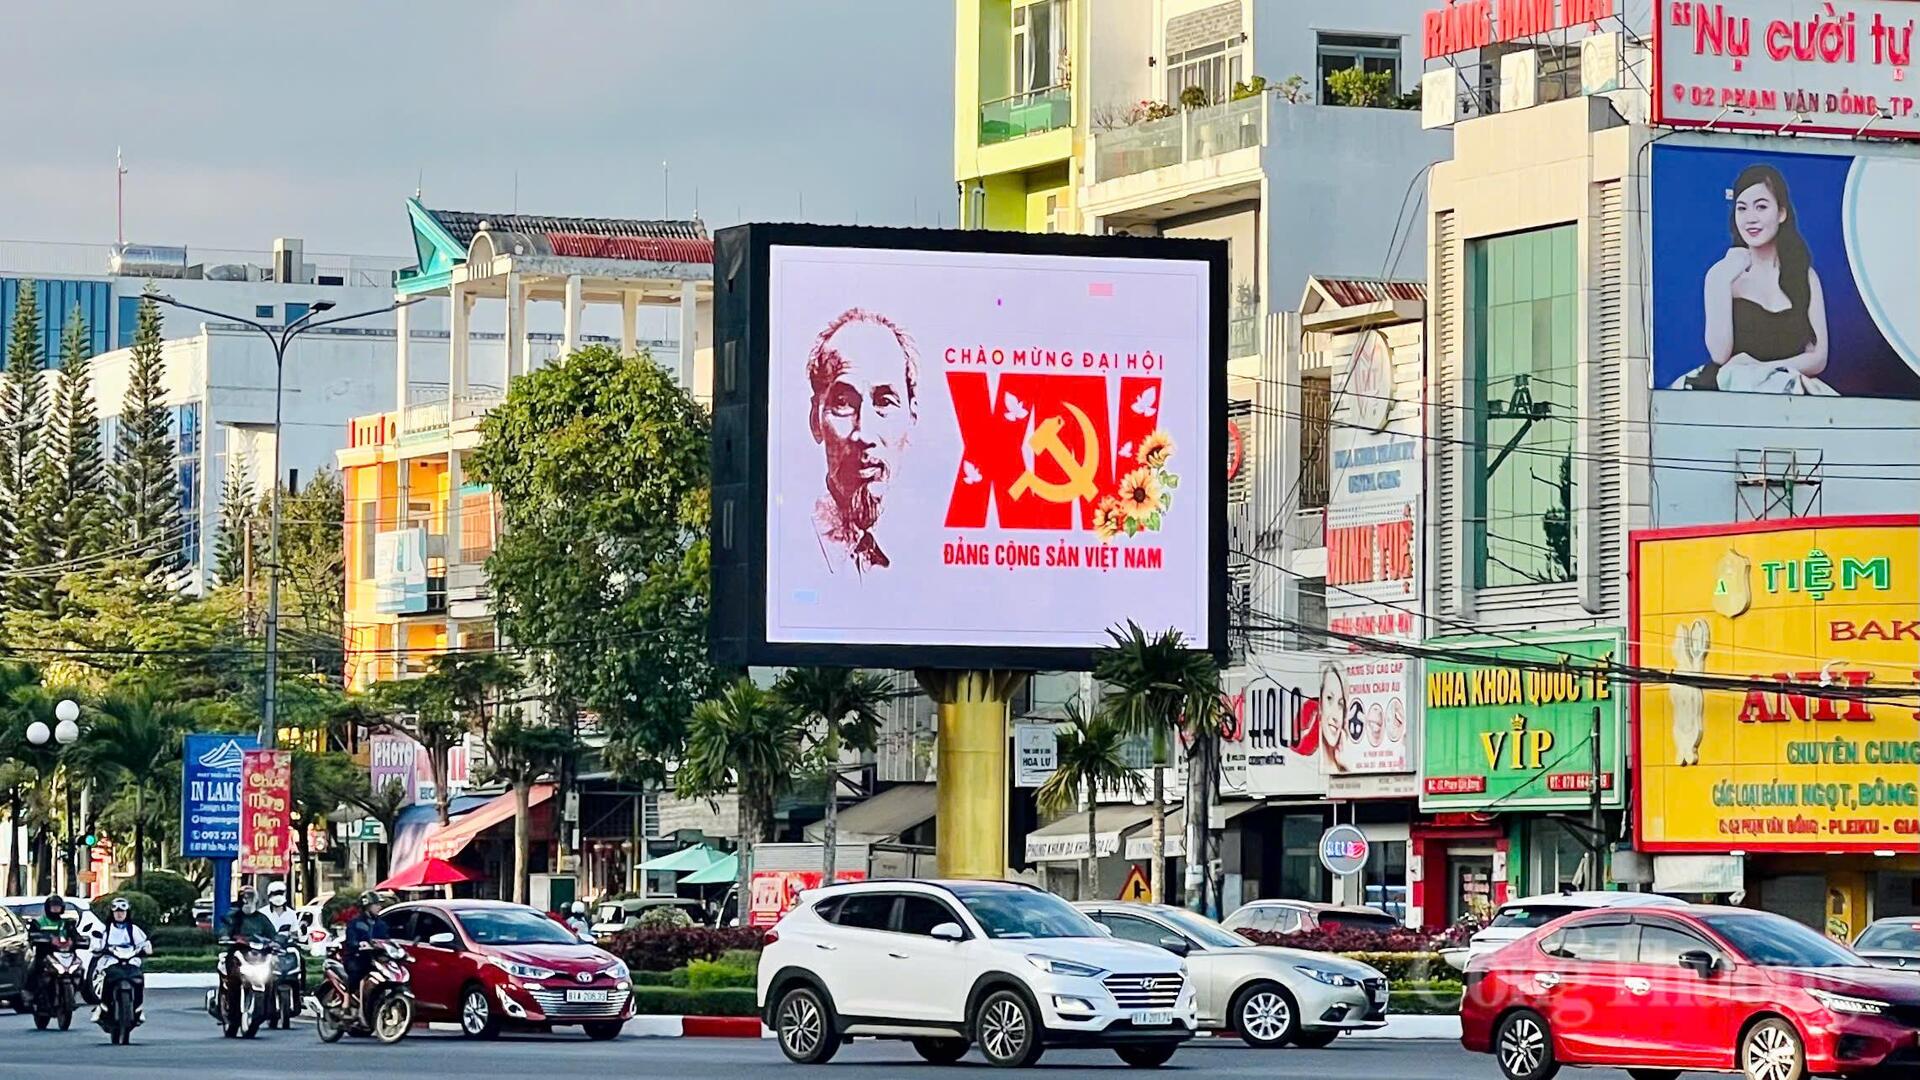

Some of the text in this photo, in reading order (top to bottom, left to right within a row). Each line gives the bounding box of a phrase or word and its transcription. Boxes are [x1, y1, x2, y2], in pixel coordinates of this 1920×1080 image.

[1764, 2, 1856, 63] cười
[1870, 13, 1914, 80] tự
[1783, 88, 1819, 113] VĂN
[945, 345, 1163, 375] CHÀO MỪNG ĐẠI HỘI
[944, 371, 1162, 531] XIV
[944, 536, 1162, 572] ĐẢNG CỘNG SẢN VIỆT NAM
[1761, 549, 1890, 600] TIỆM
[1427, 672, 1467, 707] NHA
[1472, 669, 1524, 705] KHOA
[374, 742, 413, 767] PHOTO
[191, 781, 204, 801] IN
[1829, 819, 1879, 834] PLEIKU
